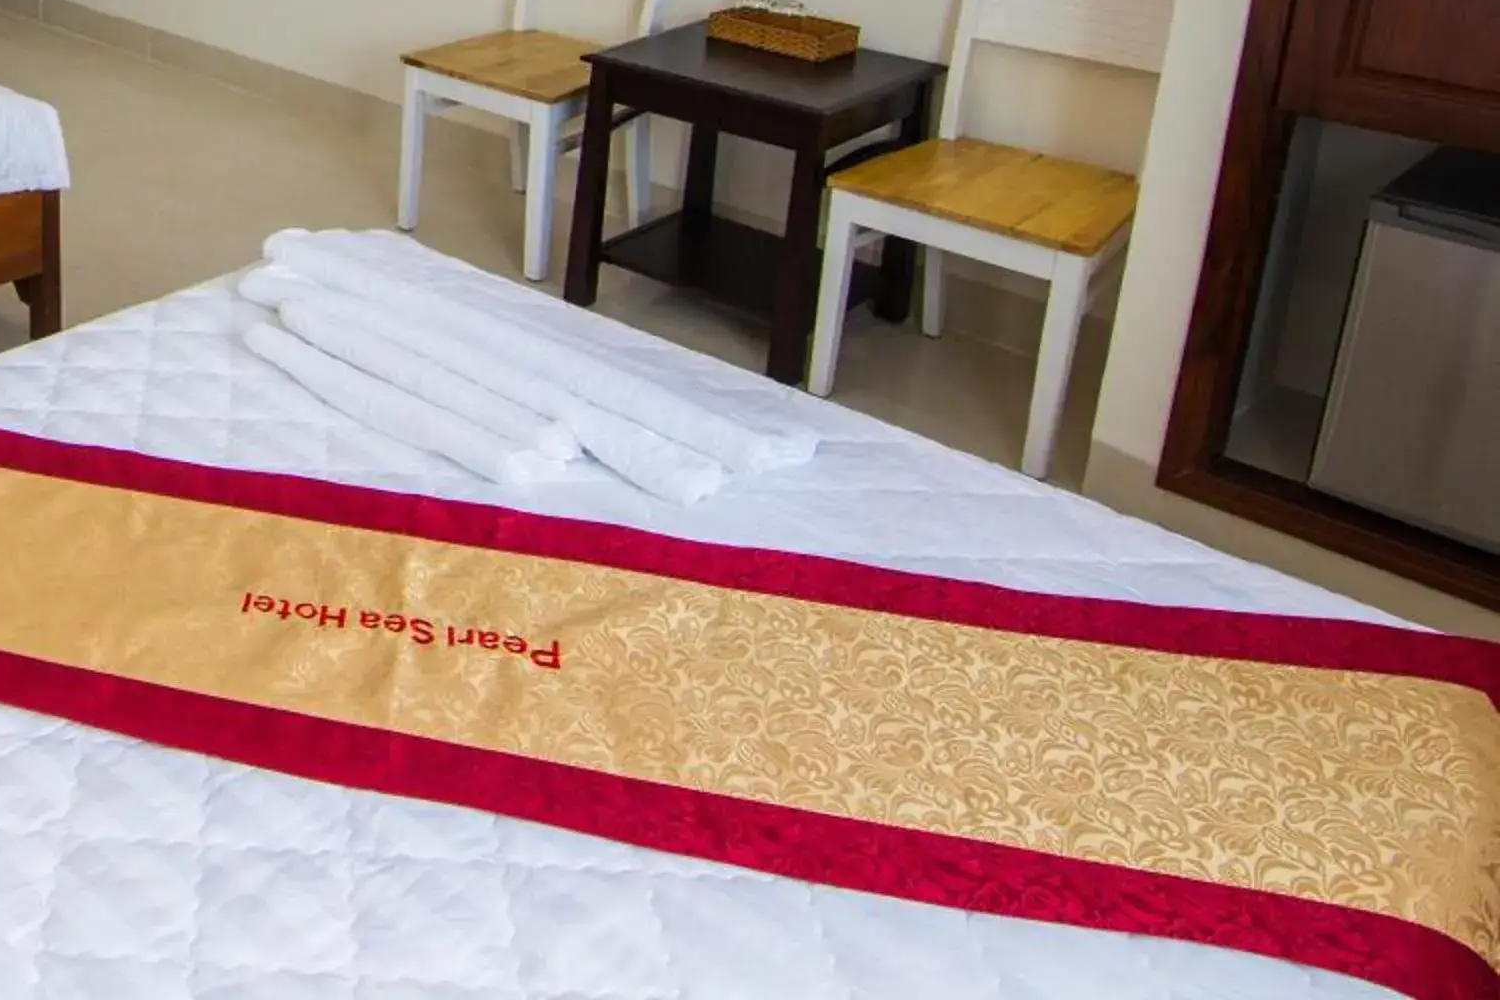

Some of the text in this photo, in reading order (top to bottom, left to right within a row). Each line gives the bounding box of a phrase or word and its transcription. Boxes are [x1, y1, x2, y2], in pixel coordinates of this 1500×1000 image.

[240, 592, 563, 671] Pearl Sea Hotel
